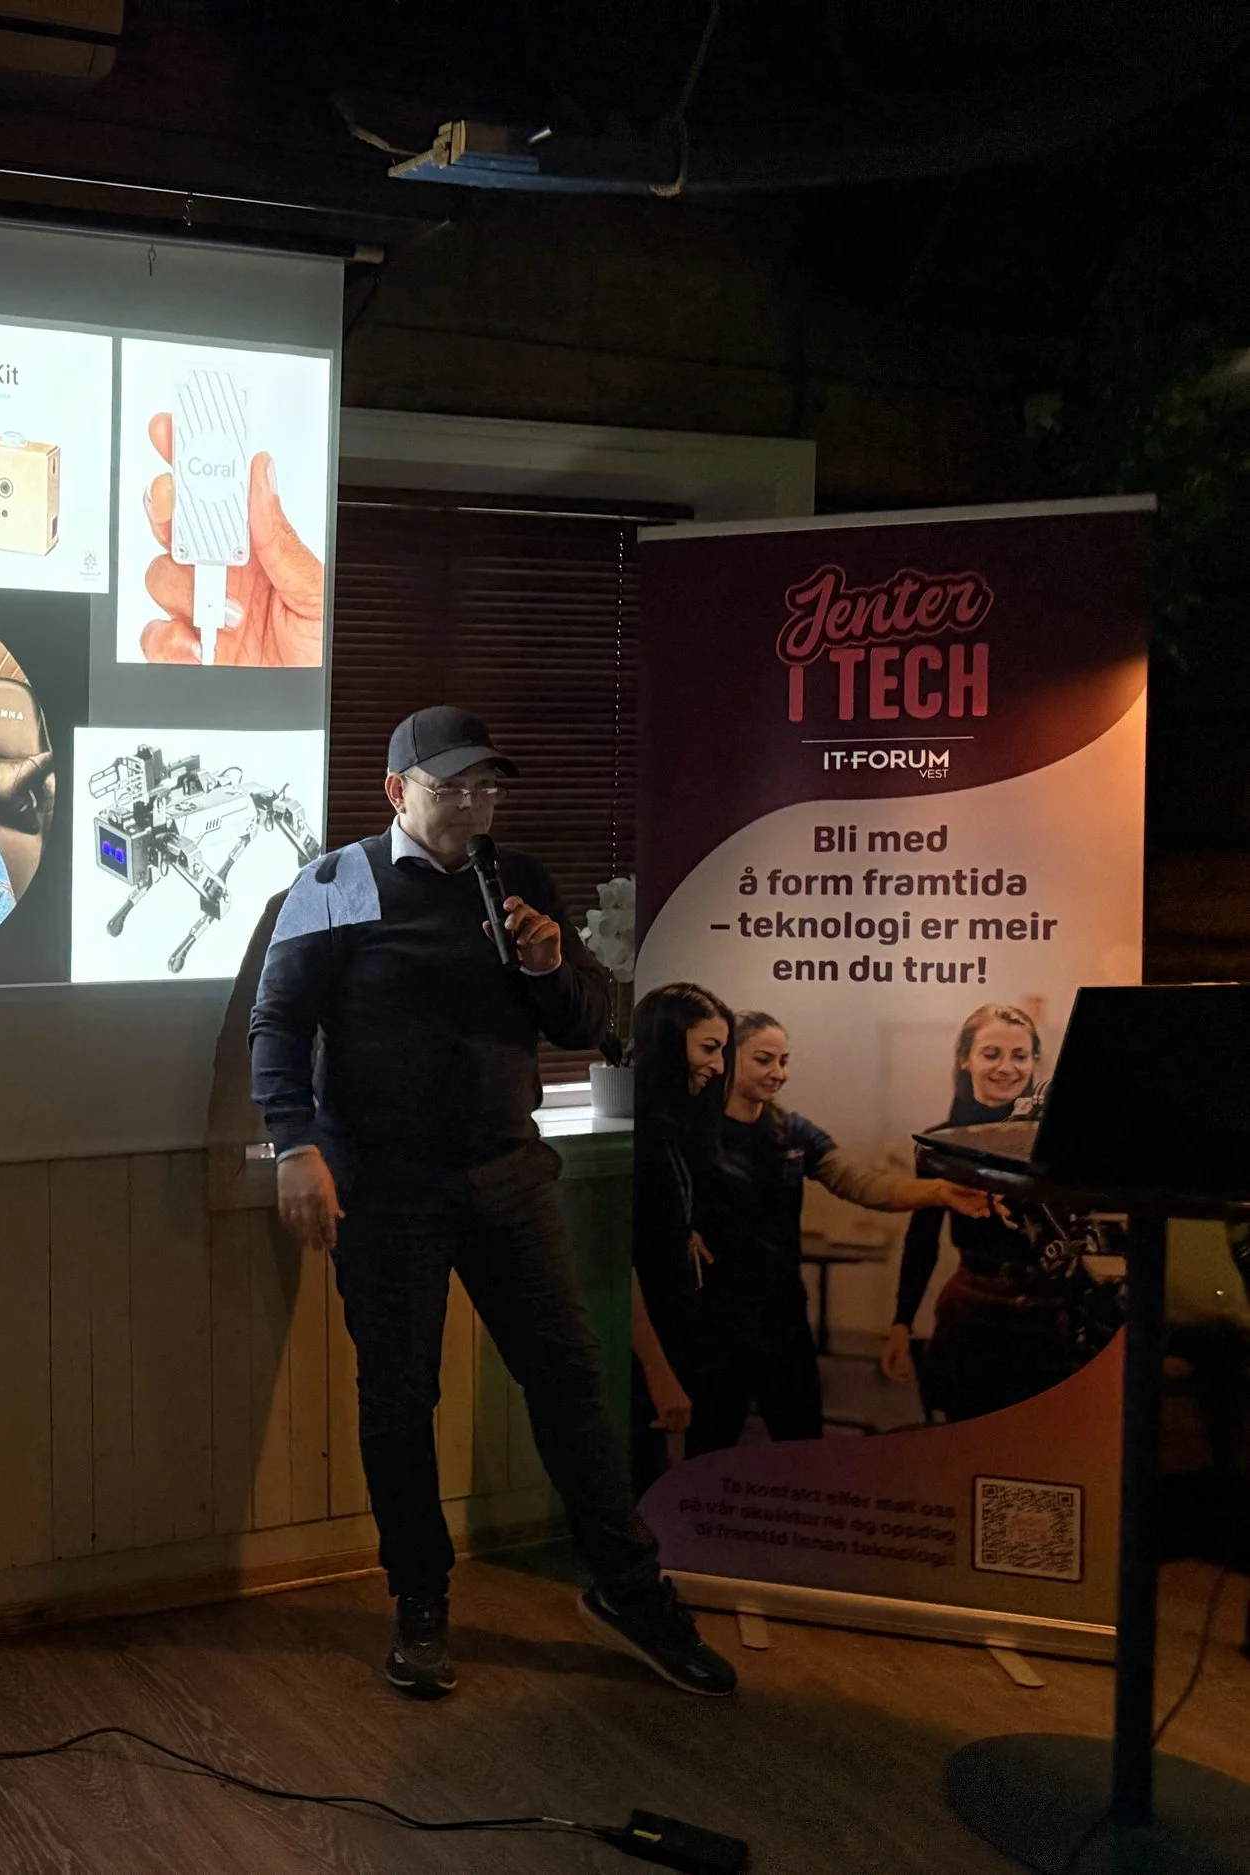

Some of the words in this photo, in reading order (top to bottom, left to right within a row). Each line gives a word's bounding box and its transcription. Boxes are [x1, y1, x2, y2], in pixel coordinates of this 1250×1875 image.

[188, 456, 236, 480] Coral
[785, 572, 986, 658] Jenter
[829, 642, 989, 720] TECH
[919, 769, 949, 779] VEST
[814, 825, 857, 852] Bli
[868, 825, 948, 852] med
[739, 866, 757, 896] å
[767, 868, 853, 896] form
[863, 867, 1027, 897] framtida
[737, 911, 910, 945] teknologi
[921, 917, 959, 939] er
[968, 911, 1058, 940] meir
[773, 958, 839, 981] enn
[849, 955, 893, 982] du
[903, 955, 987, 984] trur!
